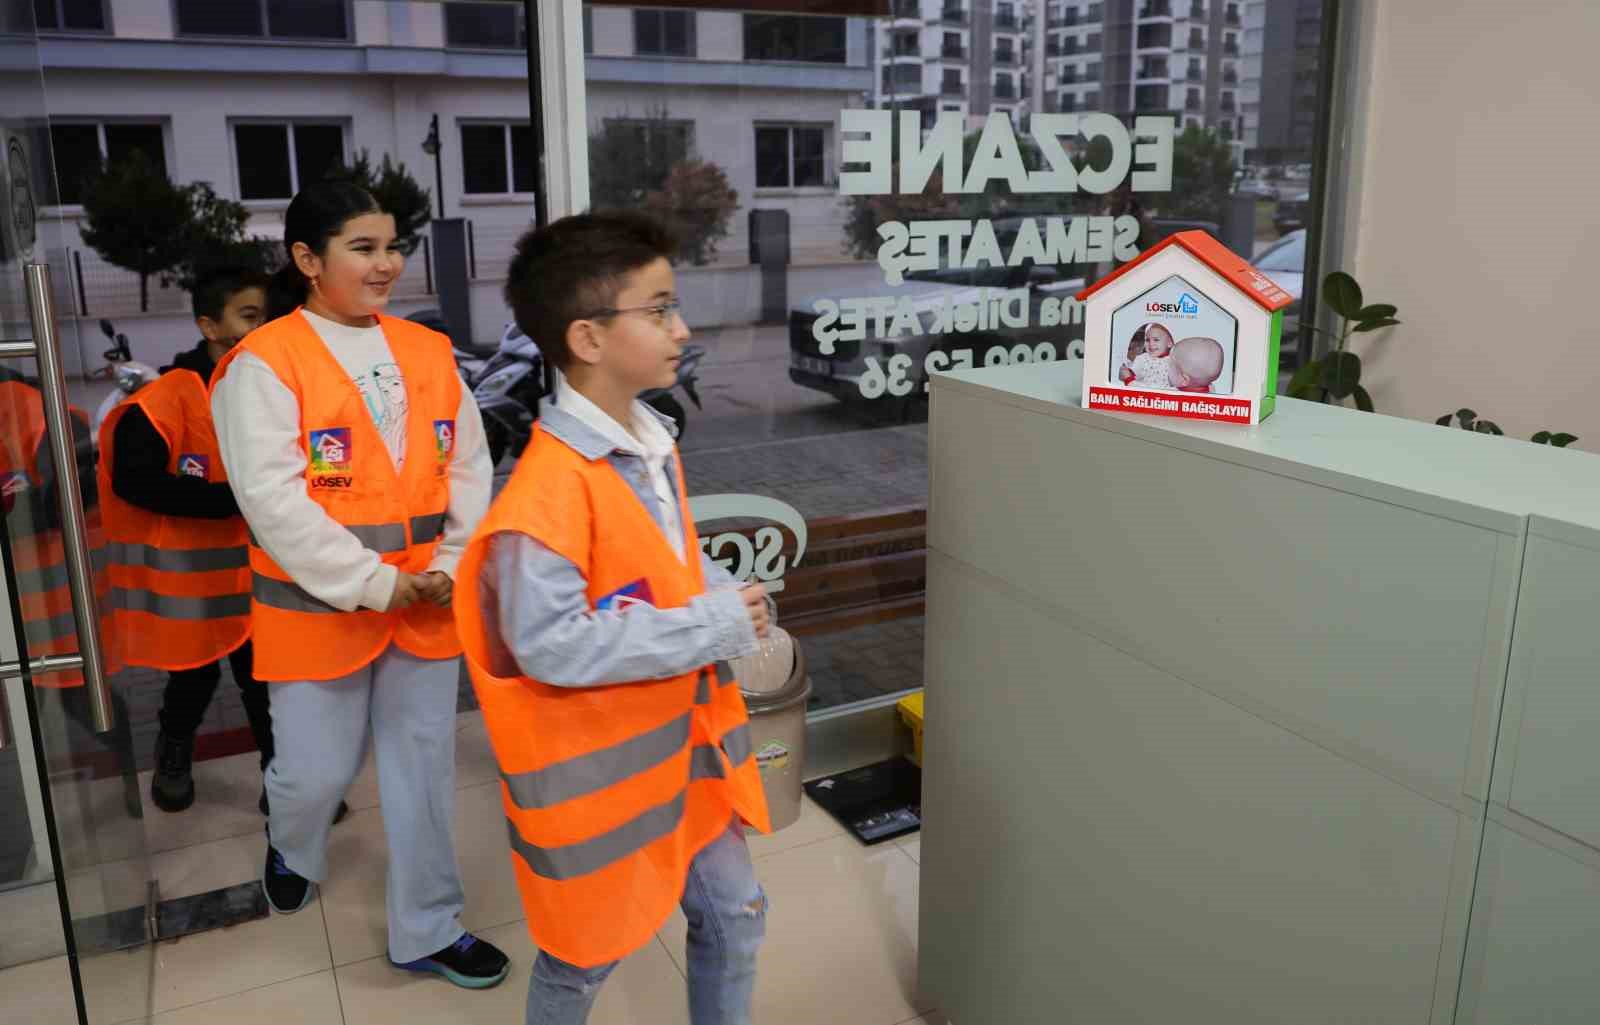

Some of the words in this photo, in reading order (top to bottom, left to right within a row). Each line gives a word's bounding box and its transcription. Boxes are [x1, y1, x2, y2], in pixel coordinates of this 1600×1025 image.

[1146, 302, 1181, 313] LÖSEV
[1090, 393, 1120, 404] BANA
[1122, 395, 1179, 412] SAĞLIĞIMI
[1182, 400, 1249, 418] BAĞIŞLAYIN
